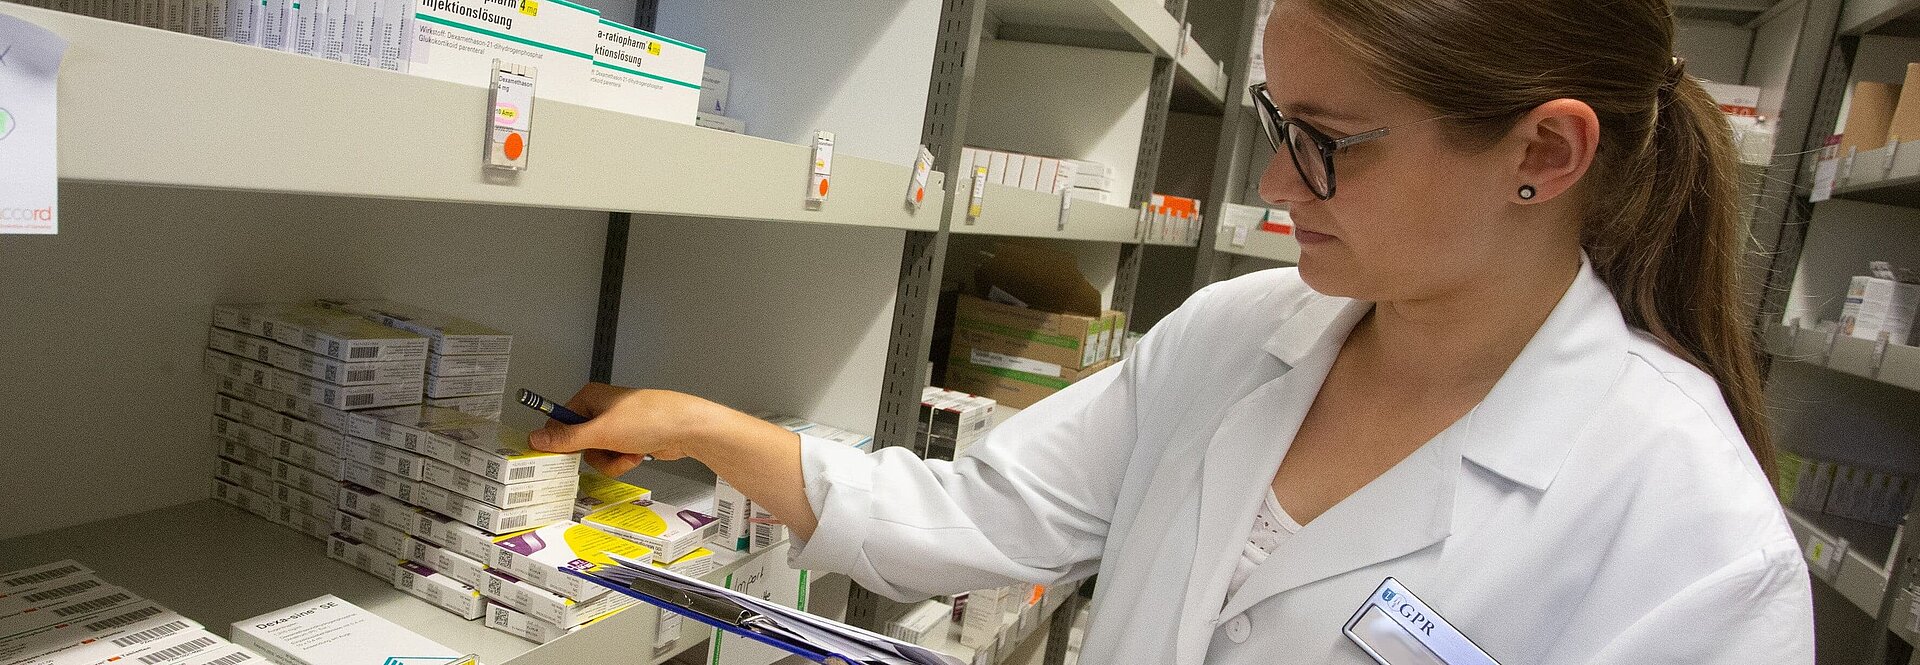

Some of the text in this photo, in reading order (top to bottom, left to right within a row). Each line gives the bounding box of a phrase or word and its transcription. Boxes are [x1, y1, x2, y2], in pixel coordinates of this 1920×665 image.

[526, 6, 538, 16] mg
[420, 25, 446, 37] Wirkstoff:
[418, 34, 485, 54] Glukokortikoid parenteral
[648, 42, 652, 51] 4
[594, 44, 642, 68] ktionslösung
[498, 75, 533, 88] Dexamethason
[0, 206, 51, 221] ccord
[320, 602, 338, 610] SE
[1400, 603, 1435, 636] GPR
